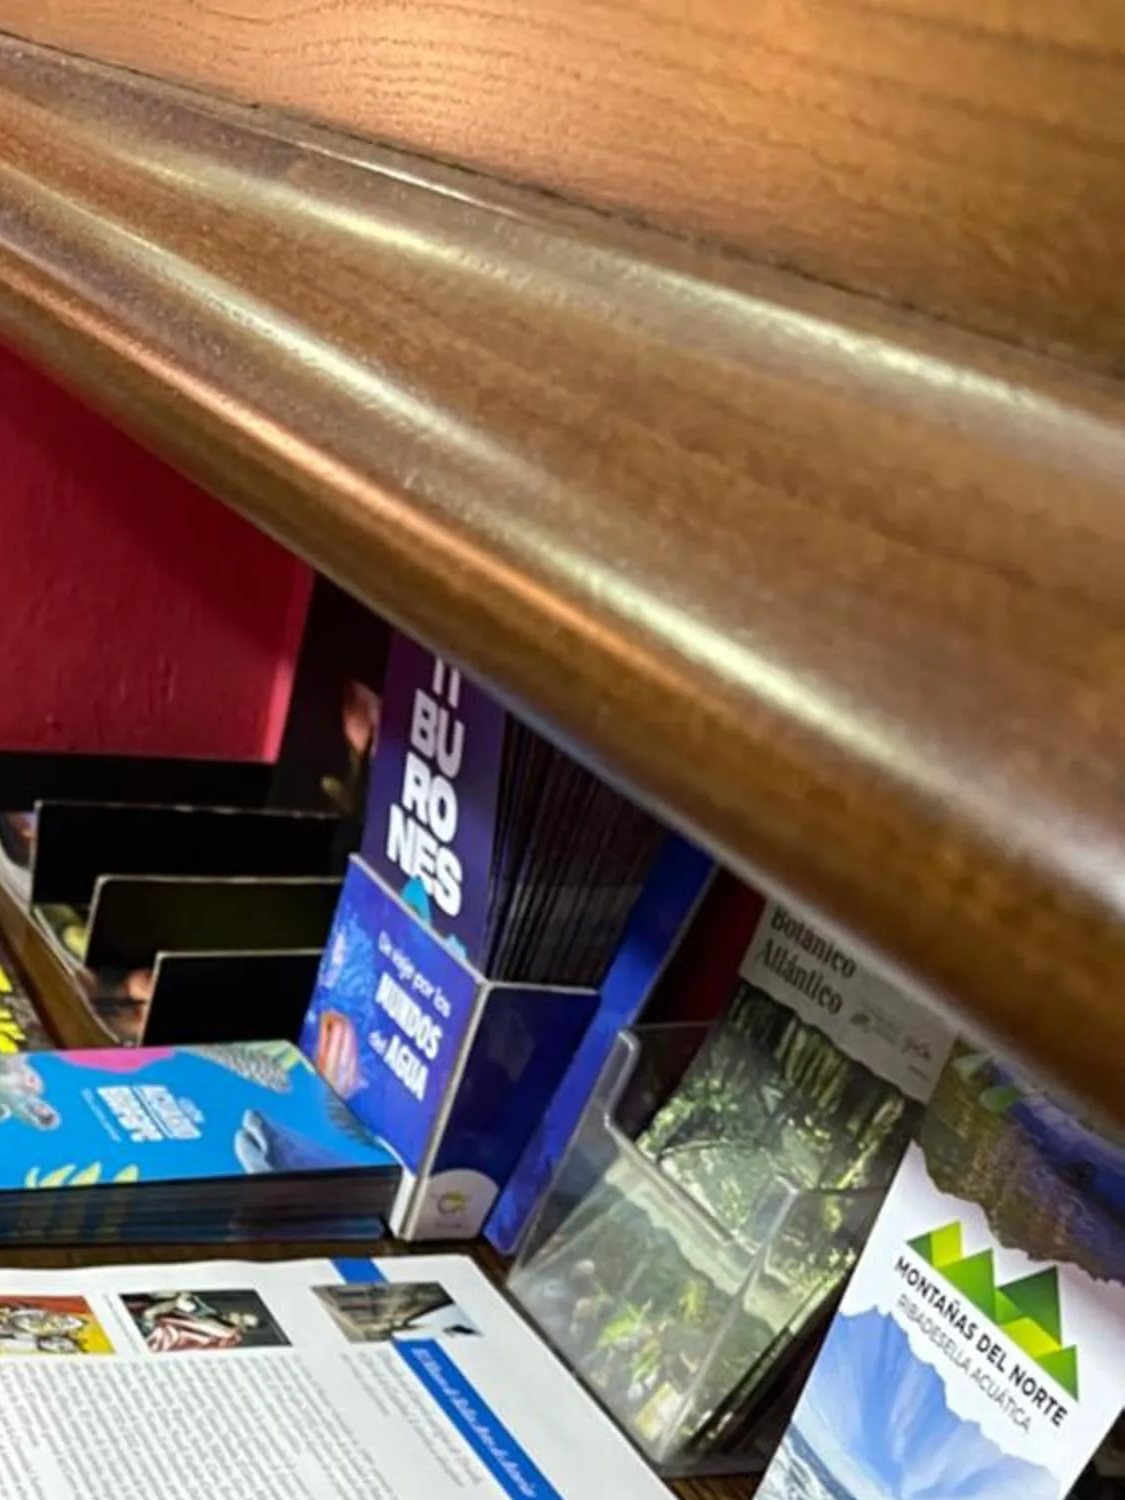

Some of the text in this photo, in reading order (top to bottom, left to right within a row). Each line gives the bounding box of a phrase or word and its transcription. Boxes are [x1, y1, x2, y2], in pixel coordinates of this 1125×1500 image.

[383, 1035, 429, 1102] AGUA
[894, 1256, 1068, 1427] MONTAÑAS DEL NORTE
[896, 1293, 1032, 1432] RIBADESELLA ACUÁTICA
